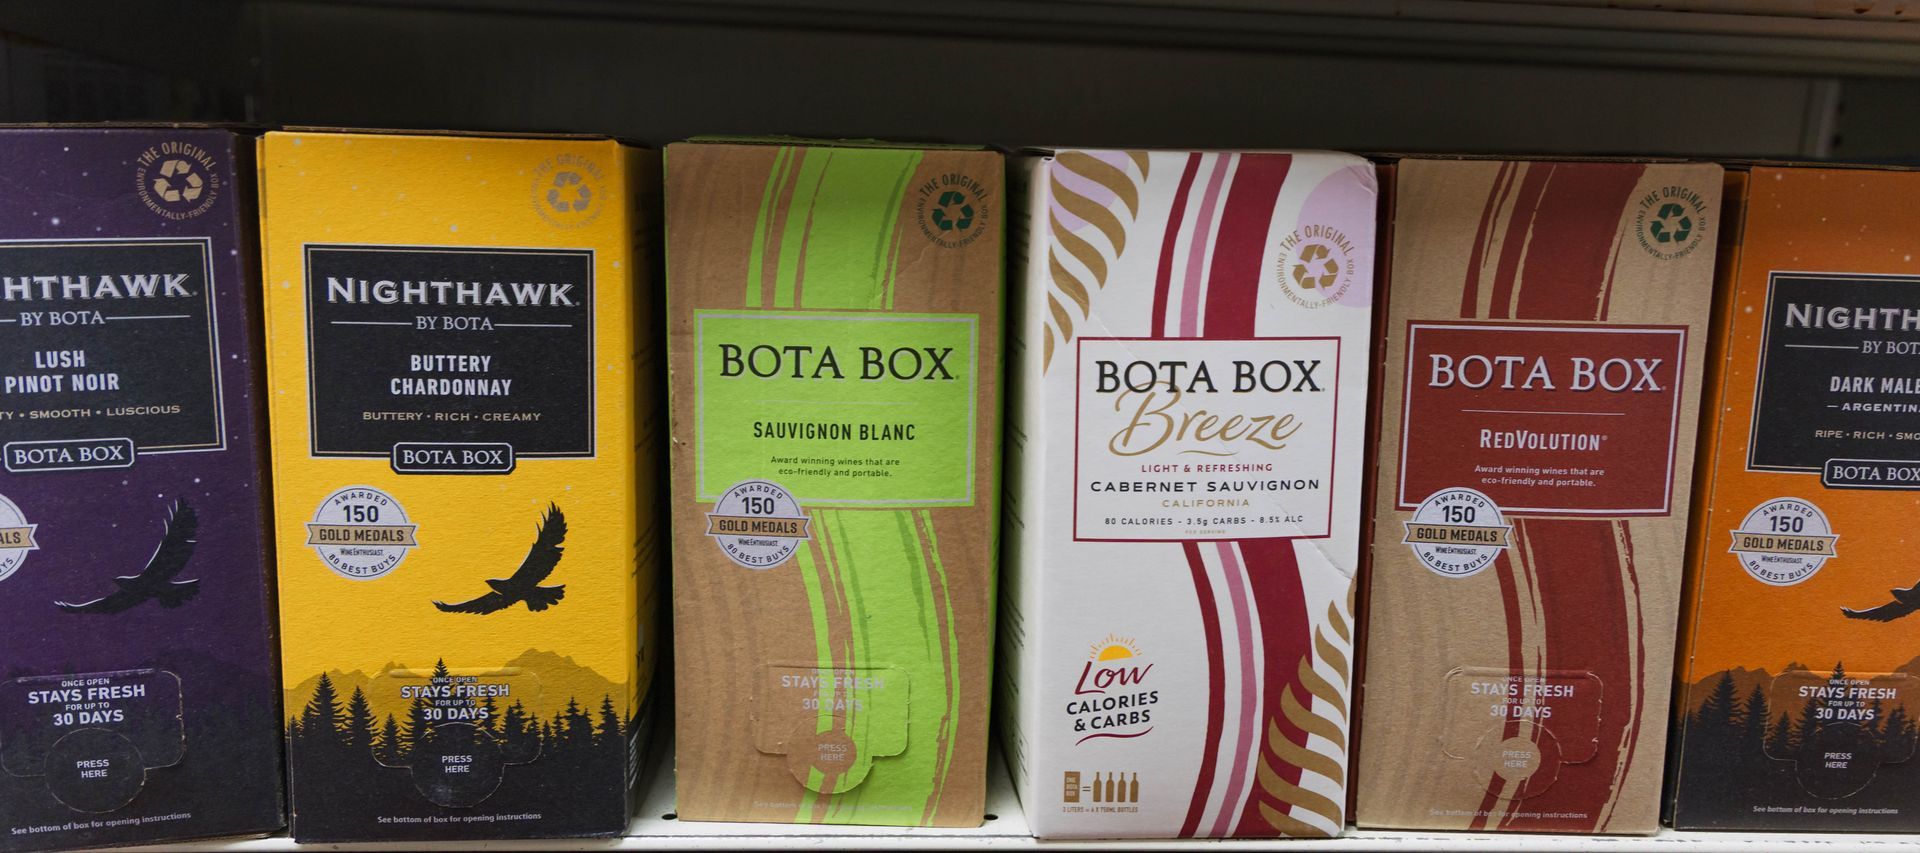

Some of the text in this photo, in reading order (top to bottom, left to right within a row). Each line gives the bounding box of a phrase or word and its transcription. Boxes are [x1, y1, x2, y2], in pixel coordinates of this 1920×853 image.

[137, 142, 216, 170] THE ORIGINAL
[1639, 185, 1707, 213] THE ORIGINAL
[1280, 224, 1355, 256] THE ORIGINAL
[327, 277, 576, 307] NIGHTHAWK
[20, 311, 105, 326] BY BOTA
[415, 316, 494, 331] BY BOTA
[1862, 341, 1883, 354] BY
[35, 350, 86, 368] LUSH
[410, 354, 491, 372] BUTTERY
[718, 343, 955, 380] BOTA BOX
[1095, 359, 1322, 393] BOTA BOX
[1428, 353, 1663, 392] BOTA BOX
[5, 373, 120, 393] PINOT NOIR
[390, 378, 512, 396] CHARDONNAY
[1830, 376, 1875, 393] DARK
[30, 405, 181, 419] SMOOTH LUSCIOUS
[363, 411, 542, 422] BUTTERY RICH CREAMY
[1108, 380, 1303, 457] Breeze
[753, 421, 916, 441] SAUVIGNON BLANC
[1815, 430, 1843, 439] RIPE
[1853, 431, 1885, 440] RICH
[14, 445, 125, 464] BOTA BOX
[403, 450, 504, 465] BOTA BOX
[771, 456, 798, 464] Award
[801, 456, 835, 466] winning
[865, 458, 883, 466] that
[778, 467, 893, 478] eco-friendly and portable.
[1141, 463, 1273, 473] LIGHT & REFRESHING
[1474, 464, 1503, 473] Award
[1505, 464, 1540, 475] winning
[1542, 466, 1568, 475] wines
[1570, 467, 1588, 475] that
[1833, 465, 1920, 482] BOTA BOX
[1090, 479, 1320, 492] CABERNET SAUVIGNON
[1481, 476, 1596, 488] eco-friendly and portable.
[334, 491, 388, 506] AWARDED
[734, 485, 783, 500] AWARDED
[741, 496, 775, 515] 150
[1162, 499, 1250, 508] CALIFORNIA
[1434, 493, 1485, 508] AWARDED
[343, 505, 379, 523] 150
[1442, 505, 1476, 523] 150
[1763, 503, 1813, 518] AWARDED
[719, 519, 798, 533] GOLD MEDALS
[1105, 517, 1117, 525] 80
[1121, 517, 1173, 525] CALORIES
[1186, 517, 1208, 526] 3.5g
[1212, 517, 1247, 525] CARBS
[1284, 515, 1304, 523] ALC
[1770, 515, 1804, 533] 150
[319, 528, 404, 542] GOLD MEDALS
[1416, 527, 1498, 542] GOLD MEDALS
[1743, 536, 1824, 551] GOLD MEDALS
[727, 543, 789, 564] 80 BEST BUYS
[328, 553, 396, 574] 80 BEST BUYS
[1423, 551, 1488, 572] 80 BEST BUYS
[1748, 560, 1813, 580] 80 BEST BUYS
[86, 678, 110, 686] OPEN
[781, 675, 885, 690] STAYS FRESH
[1470, 682, 1574, 697] STAYS FRESH
[28, 684, 146, 704] STAYS FRESH
[401, 685, 510, 699] STAYS FRESH
[1798, 686, 1896, 699] STAYS FRESH
[65, 703, 83, 711] FOR
[802, 698, 863, 711] 30 DAYS
[1066, 690, 1159, 715] CALORIES
[53, 709, 124, 726] 30 DAYS
[423, 707, 489, 721] 30 DAYS
[1490, 704, 1552, 718] 30 DAYS
[1815, 708, 1875, 721] 30 DAYS
[1074, 709, 1151, 732] & CARBS
[76, 759, 110, 768] PRESS
[441, 755, 473, 763] PRESS
[1824, 752, 1852, 760] PRESS
[81, 769, 108, 778] HERE
[445, 765, 470, 773] HERE
[11, 812, 192, 835] See bottom of box for opening instructions
